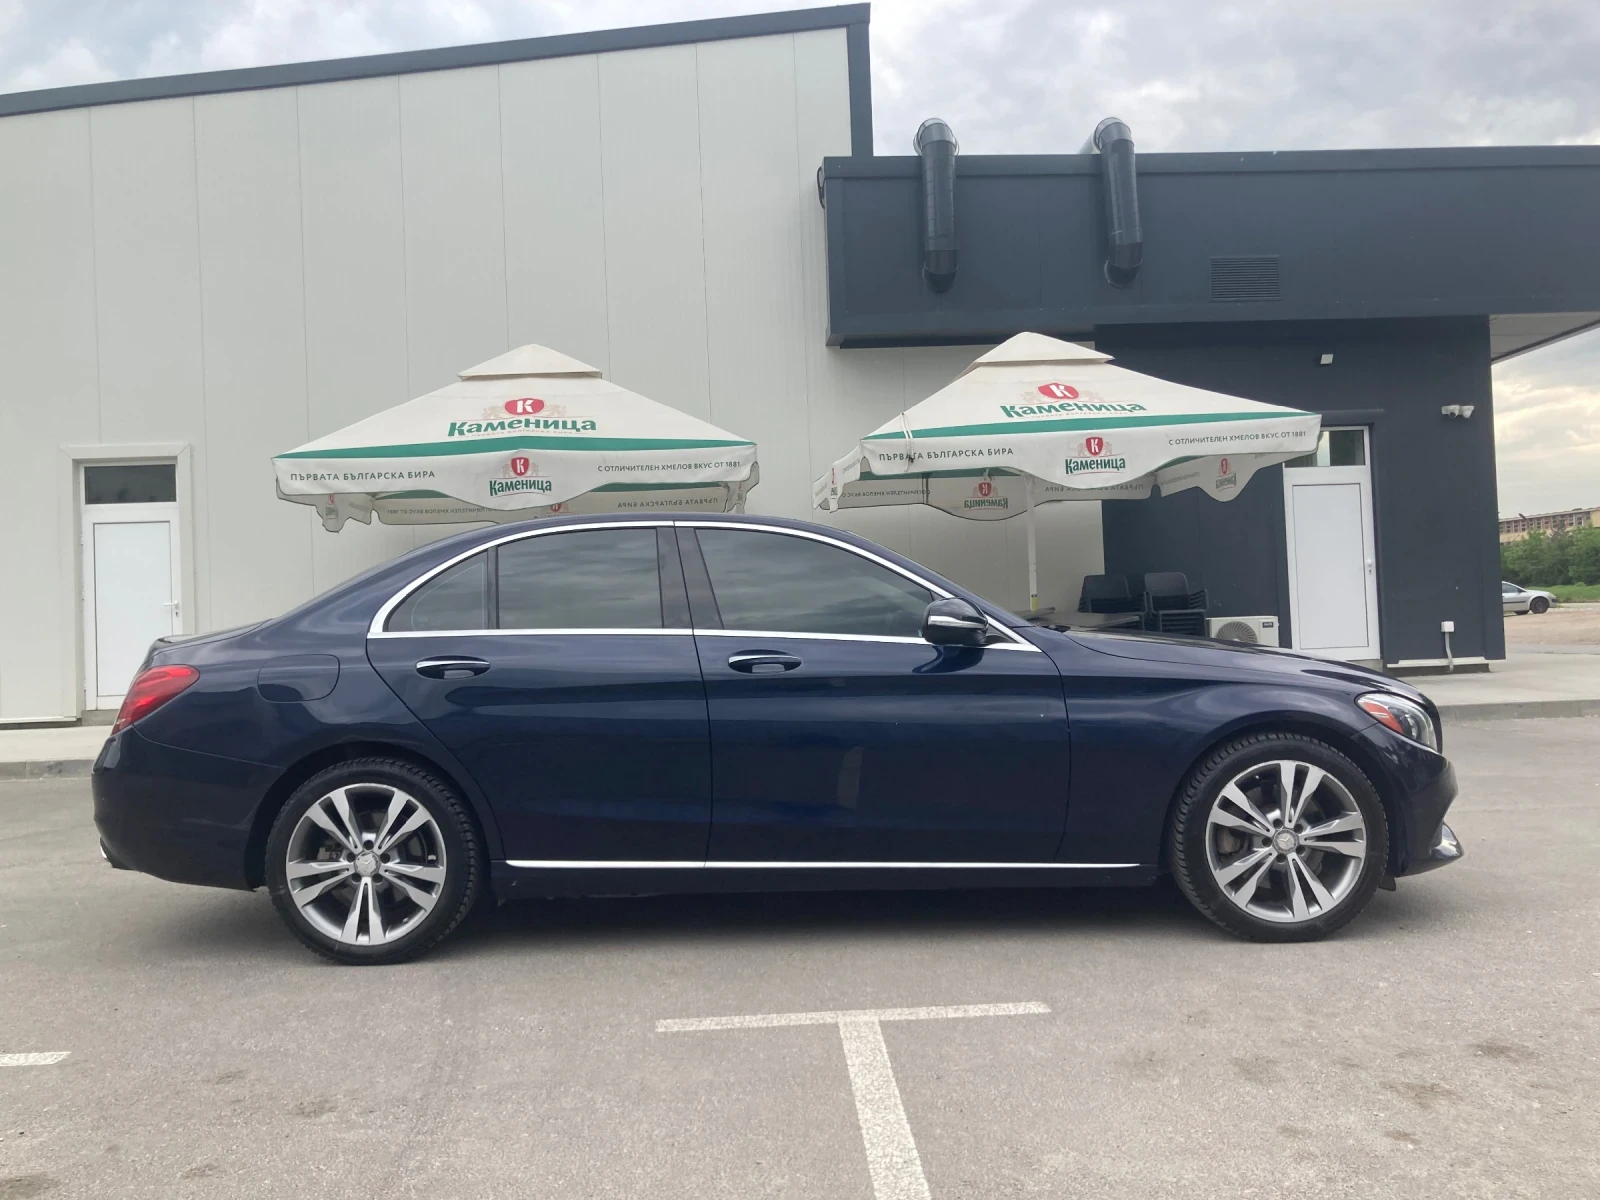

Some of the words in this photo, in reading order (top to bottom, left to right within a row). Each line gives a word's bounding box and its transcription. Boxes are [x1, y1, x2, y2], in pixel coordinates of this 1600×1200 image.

[1049, 384, 1071, 398] К
[516, 399, 534, 413] К
[1000, 401, 1147, 418] Каменица
[448, 418, 596, 436] Каменица
[1091, 438, 1099, 453] К
[1175, 436, 1228, 445] ОТЛИЧИТЕЛЕН
[1229, 434, 1260, 442] ХМЕЛОВ
[927, 450, 984, 459] БЪЛГАРСКА
[988, 448, 1014, 456] БИРА
[516, 459, 525, 473] К
[1065, 458, 1126, 475] Каменица
[290, 472, 340, 481] ПЪРВАТА
[343, 472, 405, 480] БЪЛГАРСКА
[407, 470, 436, 479] БИРА
[489, 479, 552, 497] Каменица
